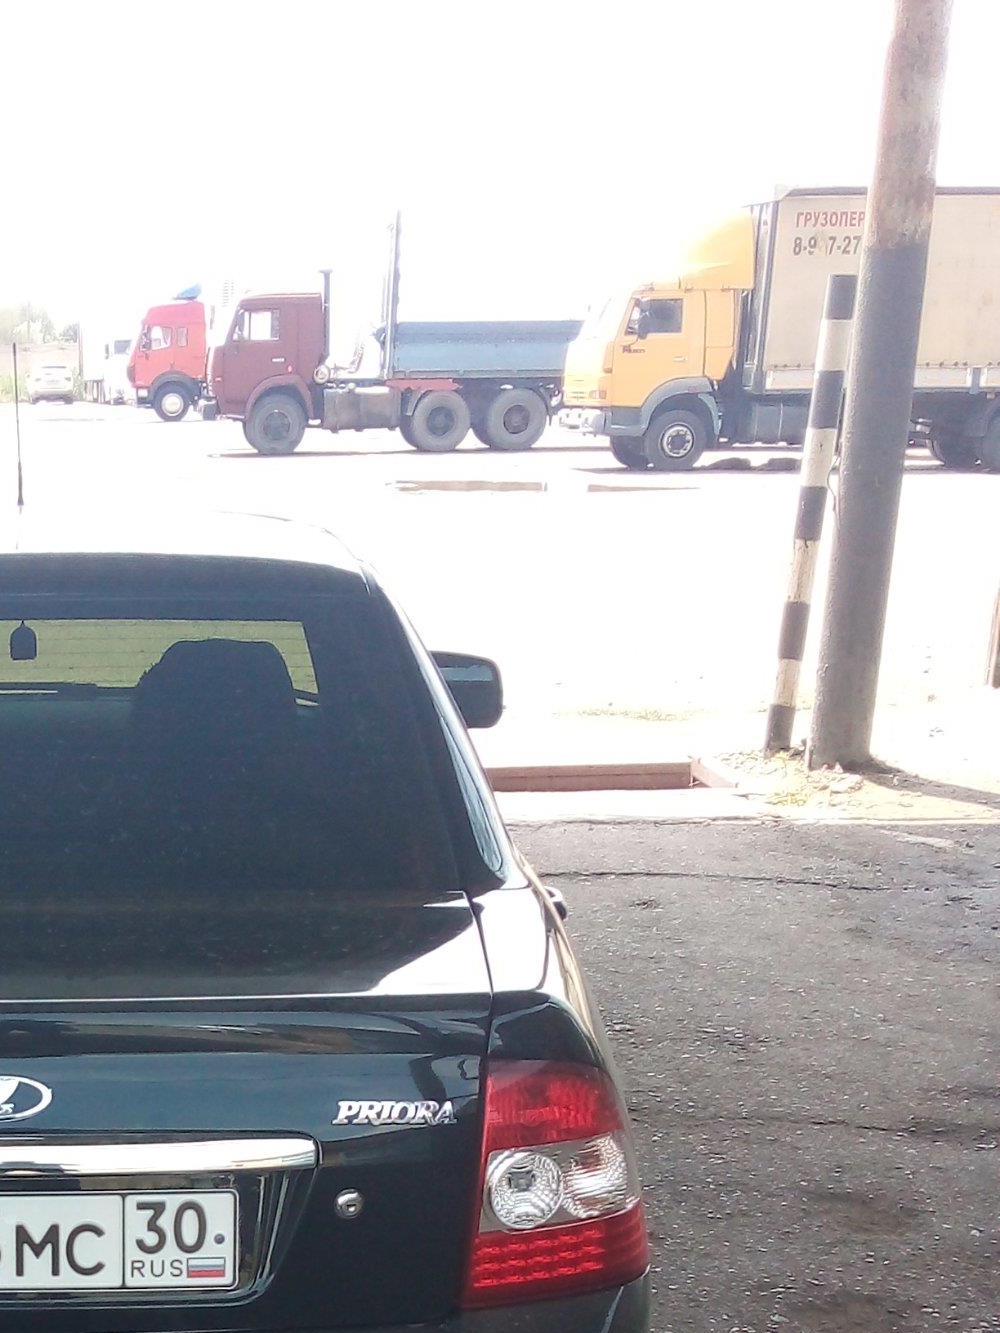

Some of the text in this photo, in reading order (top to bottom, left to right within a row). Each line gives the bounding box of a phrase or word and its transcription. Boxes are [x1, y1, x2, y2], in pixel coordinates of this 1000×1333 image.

[793, 235, 862, 256] 8-97-27
[331, 1100, 458, 1126] PRIORA
[135, 1201, 207, 1255] 30
[130, 1259, 183, 1278] RUS
